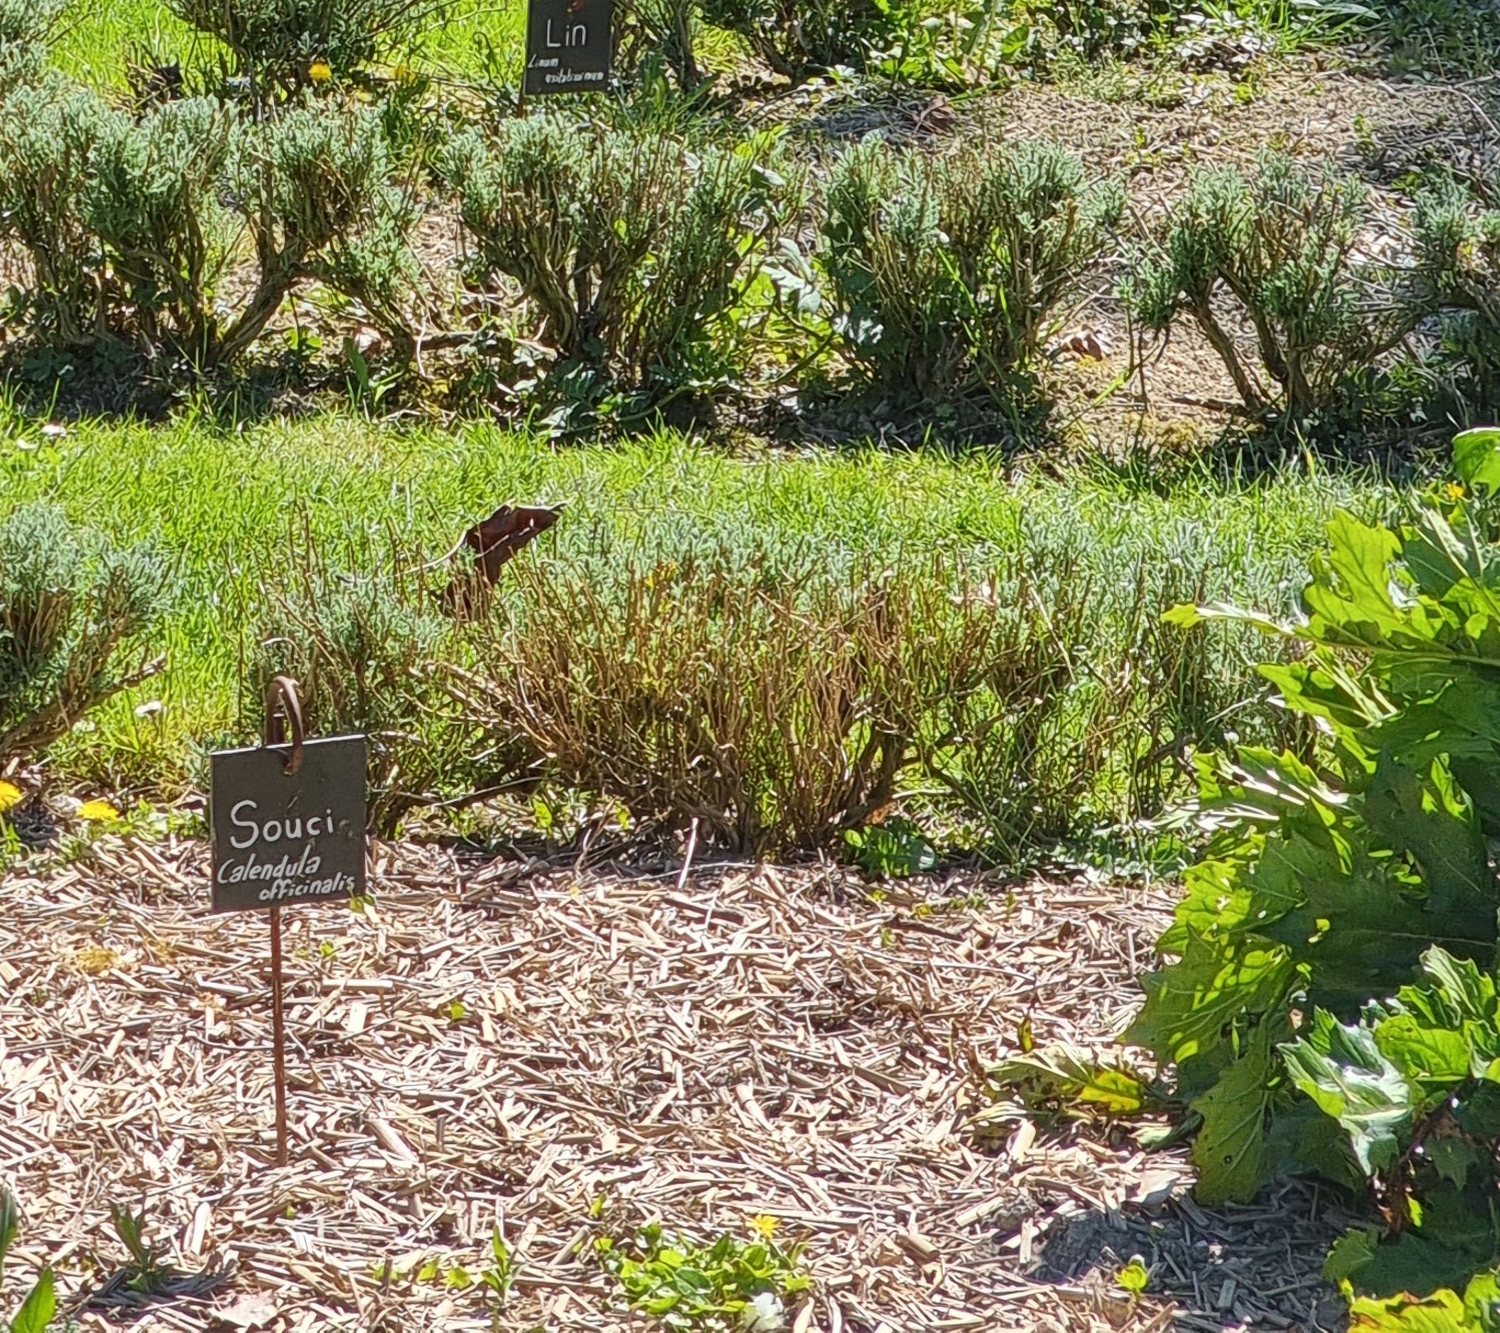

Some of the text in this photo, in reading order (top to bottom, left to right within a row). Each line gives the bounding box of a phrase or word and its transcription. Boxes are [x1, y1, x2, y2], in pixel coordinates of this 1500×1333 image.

[546, 18, 587, 47] Lin
[229, 799, 334, 849] Souci
[217, 844, 322, 884] Calendula
[259, 871, 356, 901] officinalis
